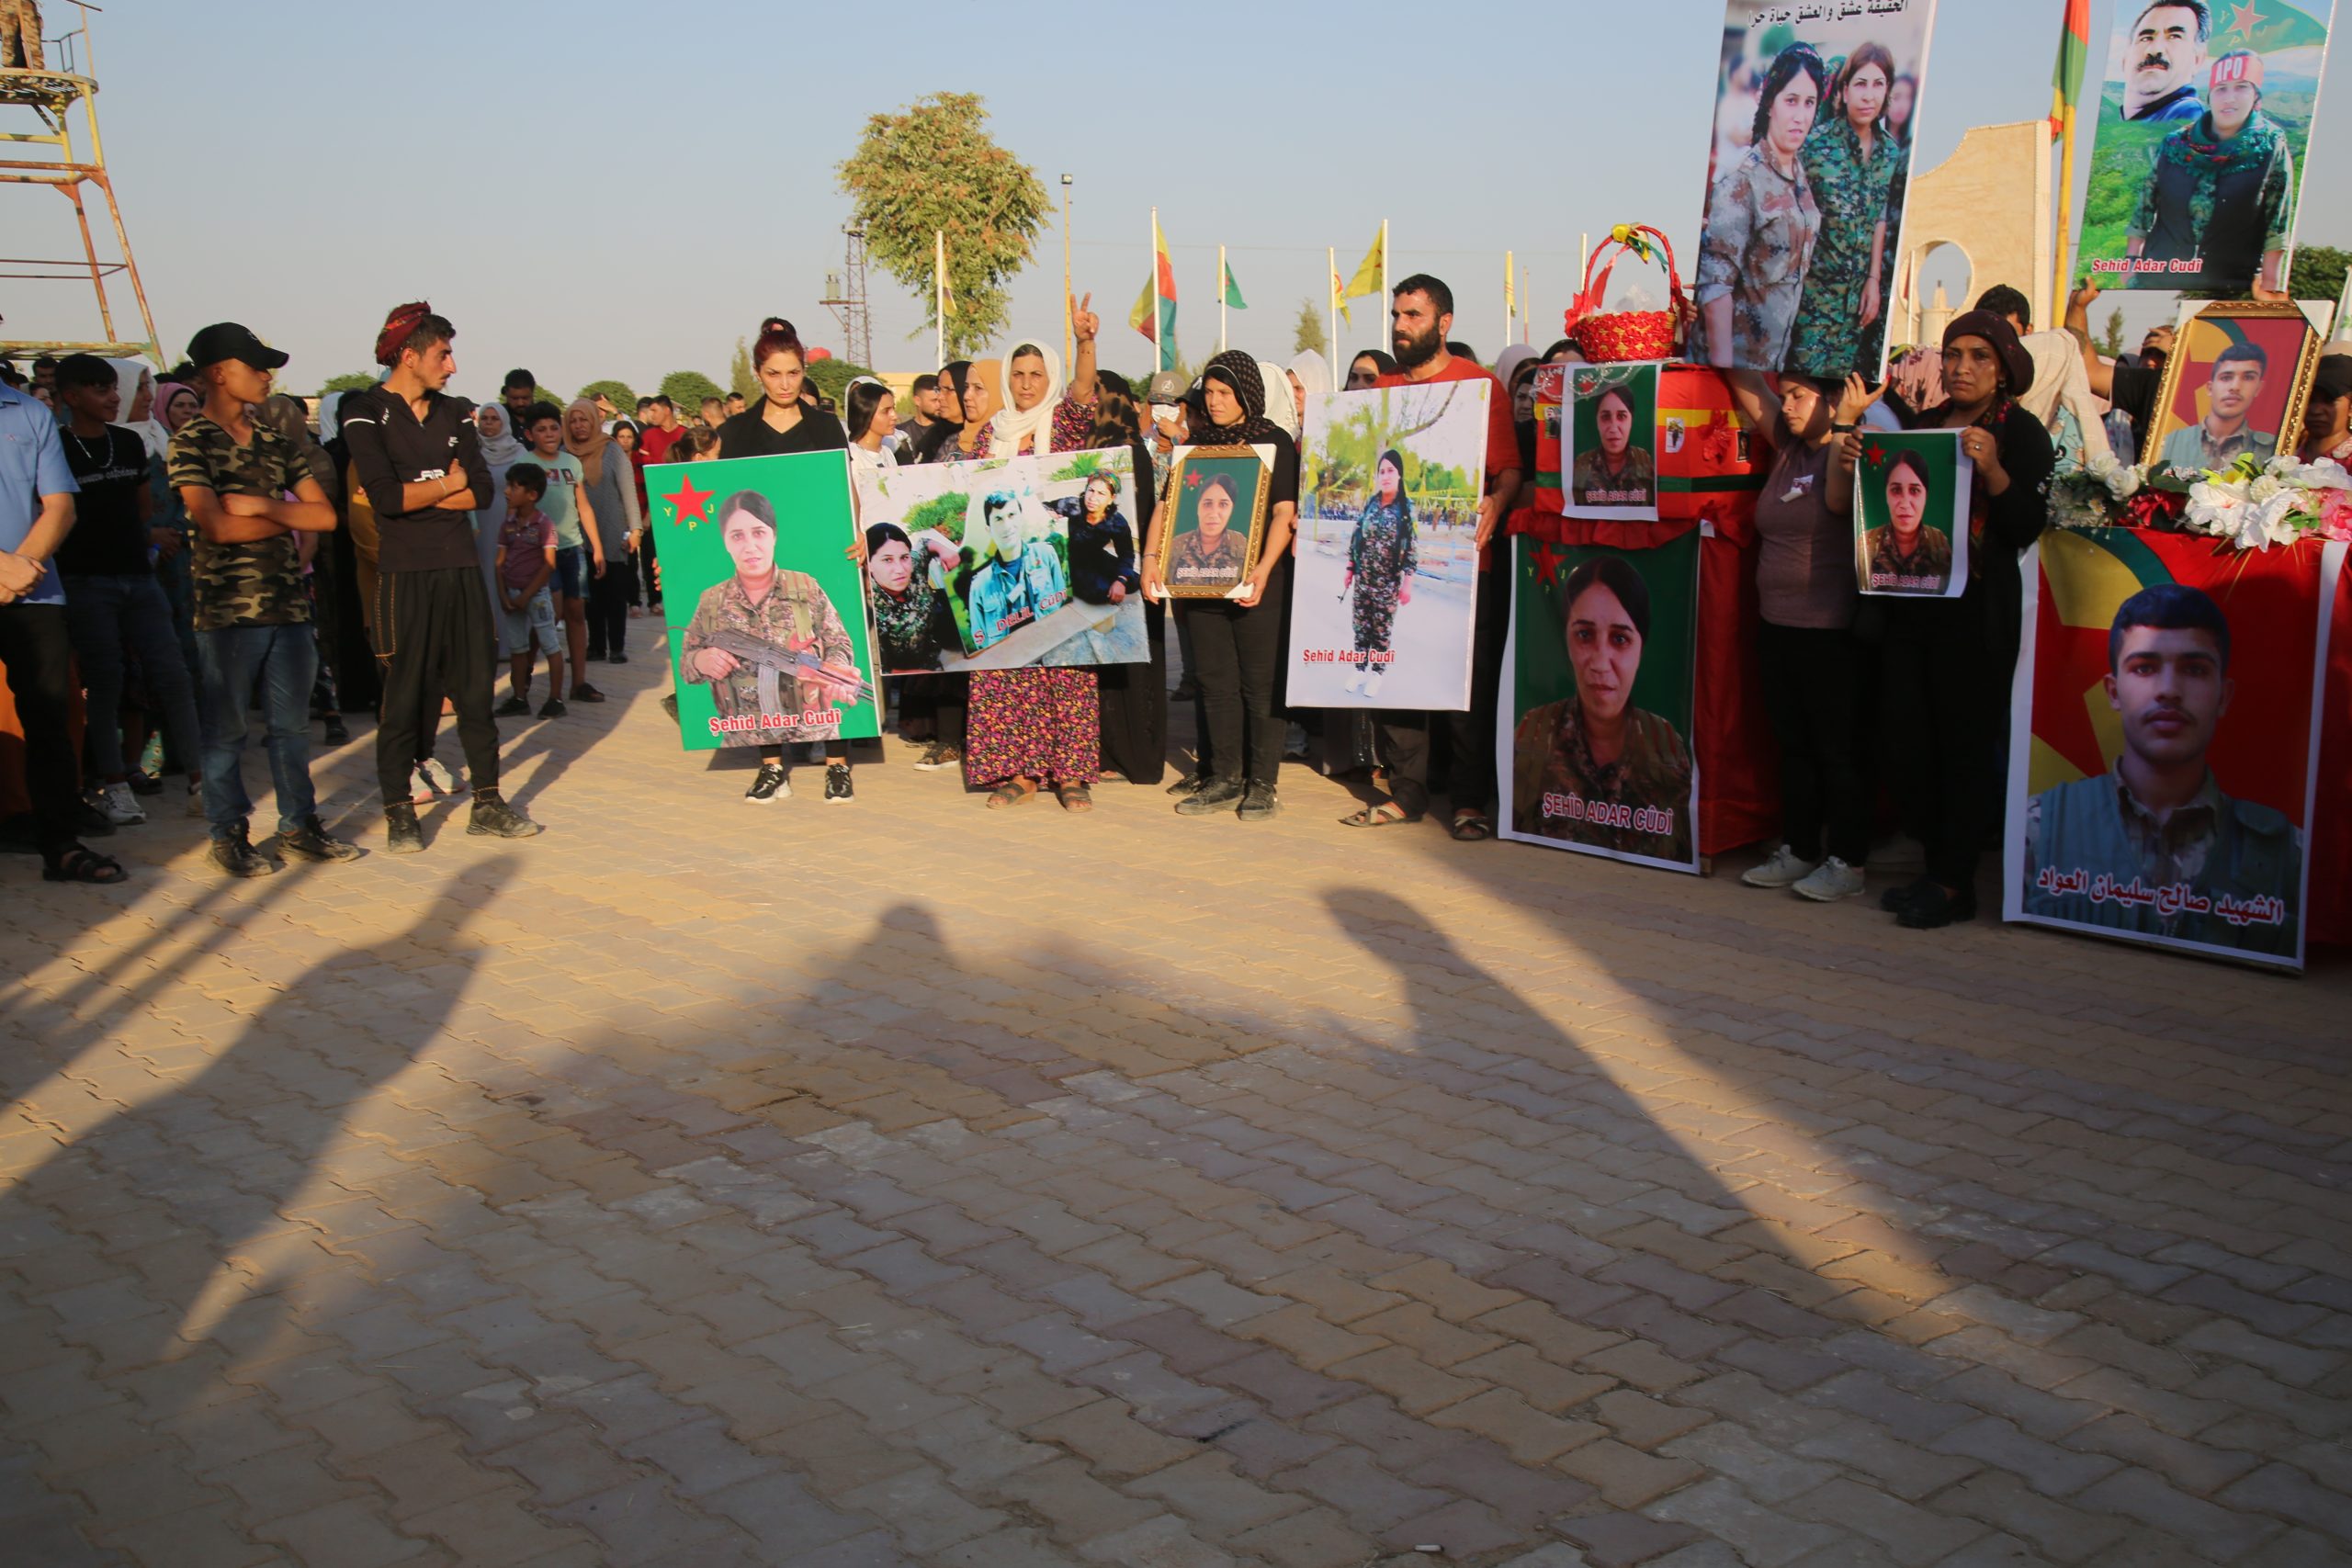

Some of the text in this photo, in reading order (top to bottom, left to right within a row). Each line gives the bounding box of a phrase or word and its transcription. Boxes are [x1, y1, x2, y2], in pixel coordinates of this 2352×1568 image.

[1837, 1, 1862, 21] عشق
[2214, 56, 2243, 84] APO
[2132, 258, 2166, 274] Adar
[688, 521, 697, 531] P
[1337, 649, 1367, 663] Adar
[760, 712, 799, 730] Adar
[1585, 800, 1632, 829] ADAR
[2036, 865, 2284, 926] الشهيد صالح سليمان العواد
